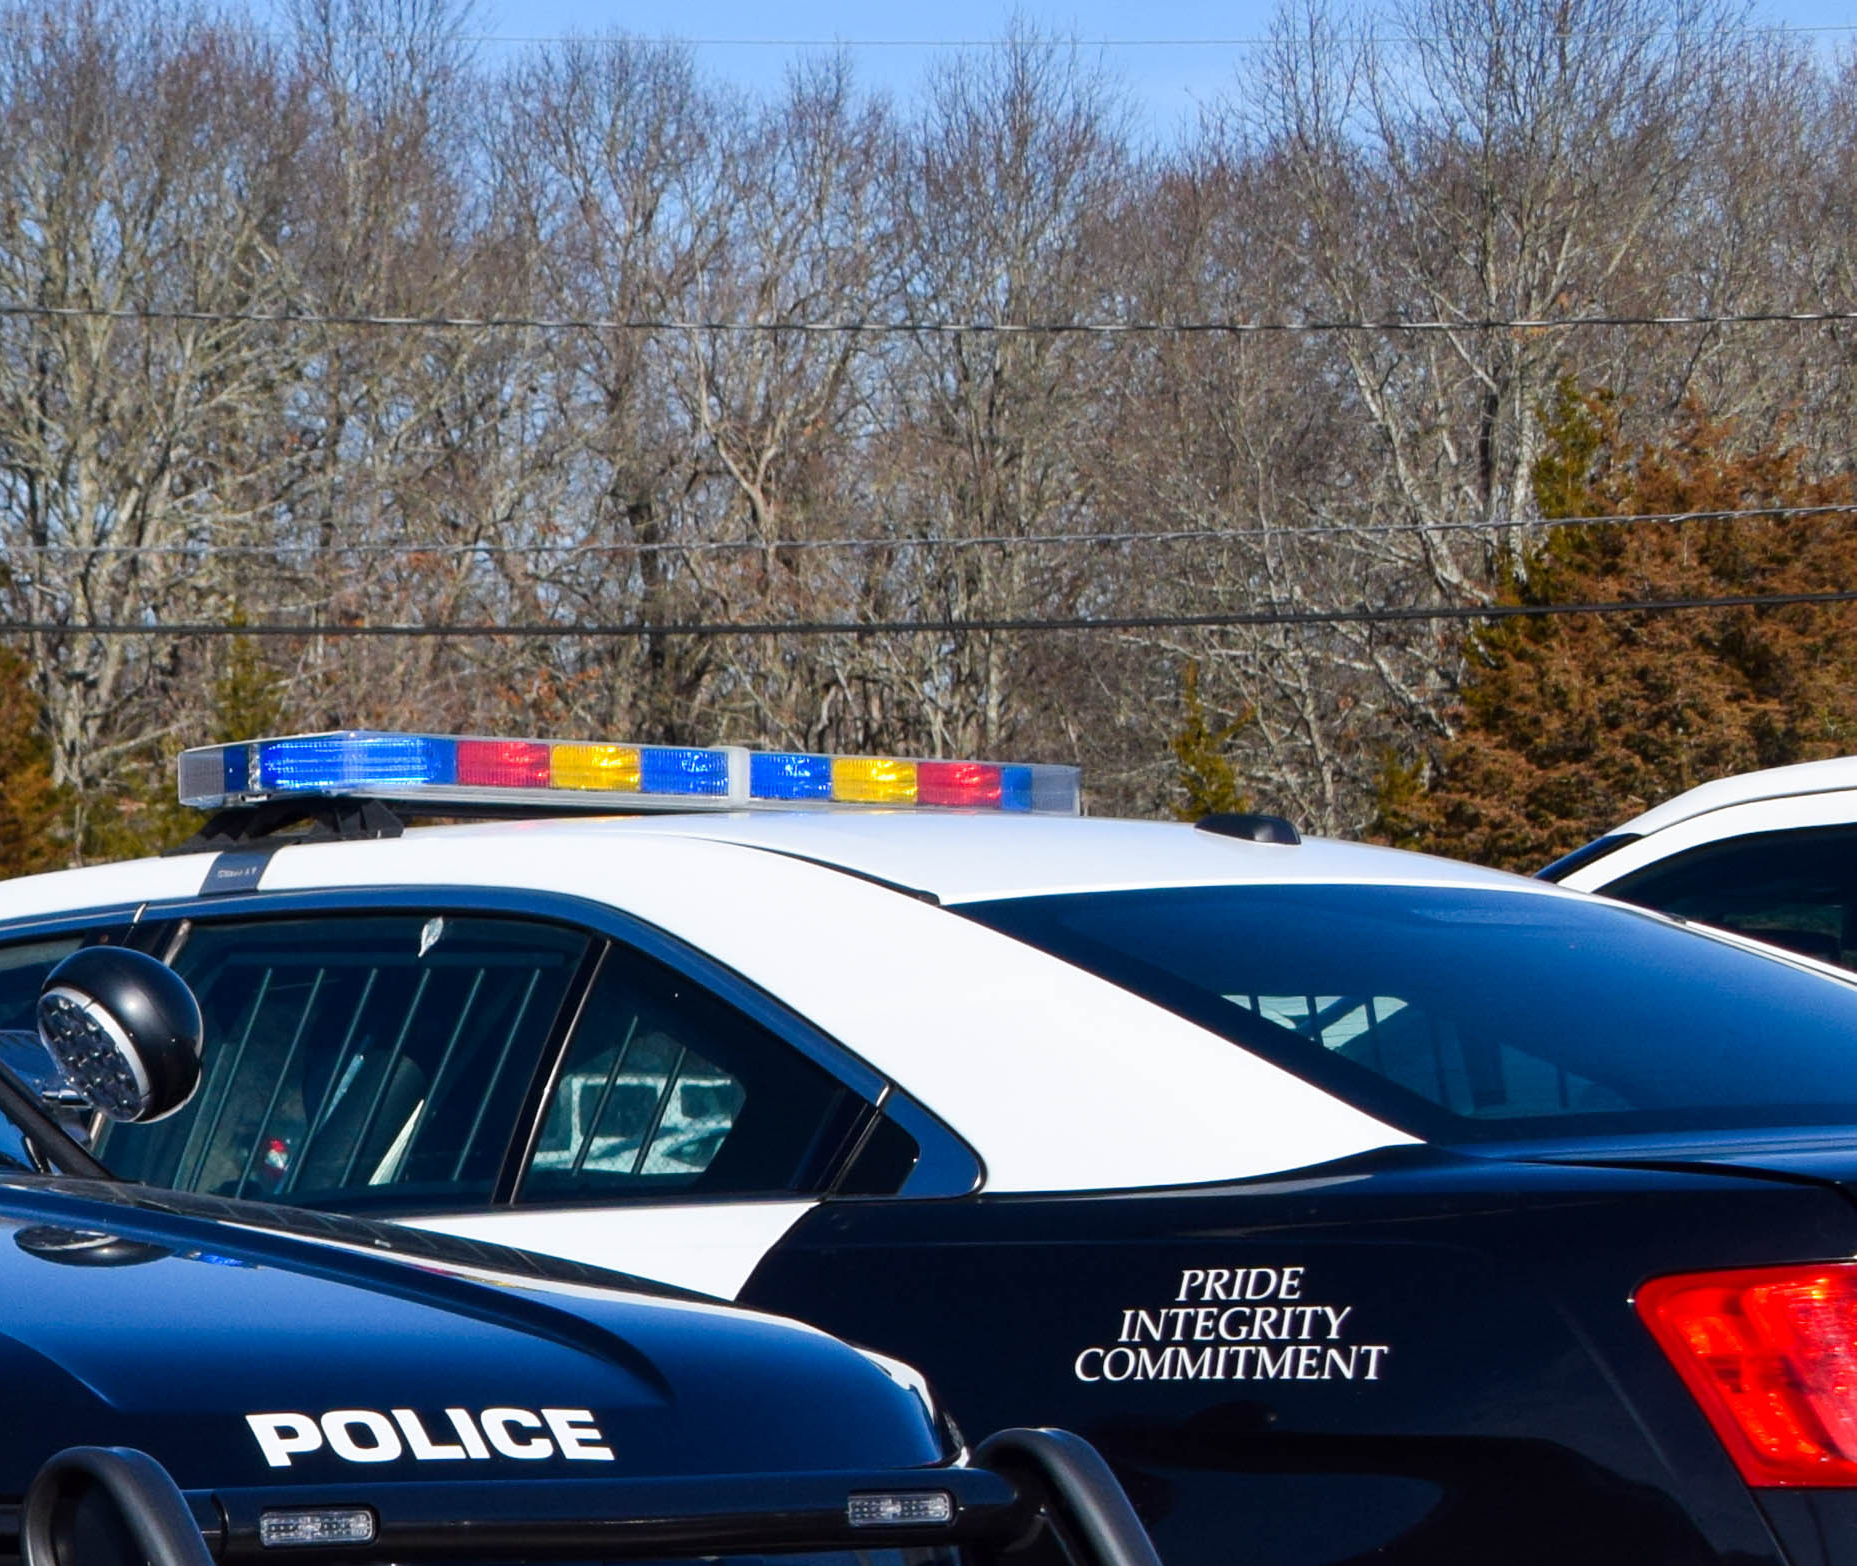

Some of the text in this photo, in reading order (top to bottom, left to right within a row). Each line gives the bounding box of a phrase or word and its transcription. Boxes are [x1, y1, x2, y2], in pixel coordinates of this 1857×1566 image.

[1175, 1267, 1305, 1301] PRIDE
[1117, 1306, 1352, 1342] INTEGRITY
[1074, 1346, 1389, 1382] COMMITMENT
[245, 1408, 615, 1467] POLICE
